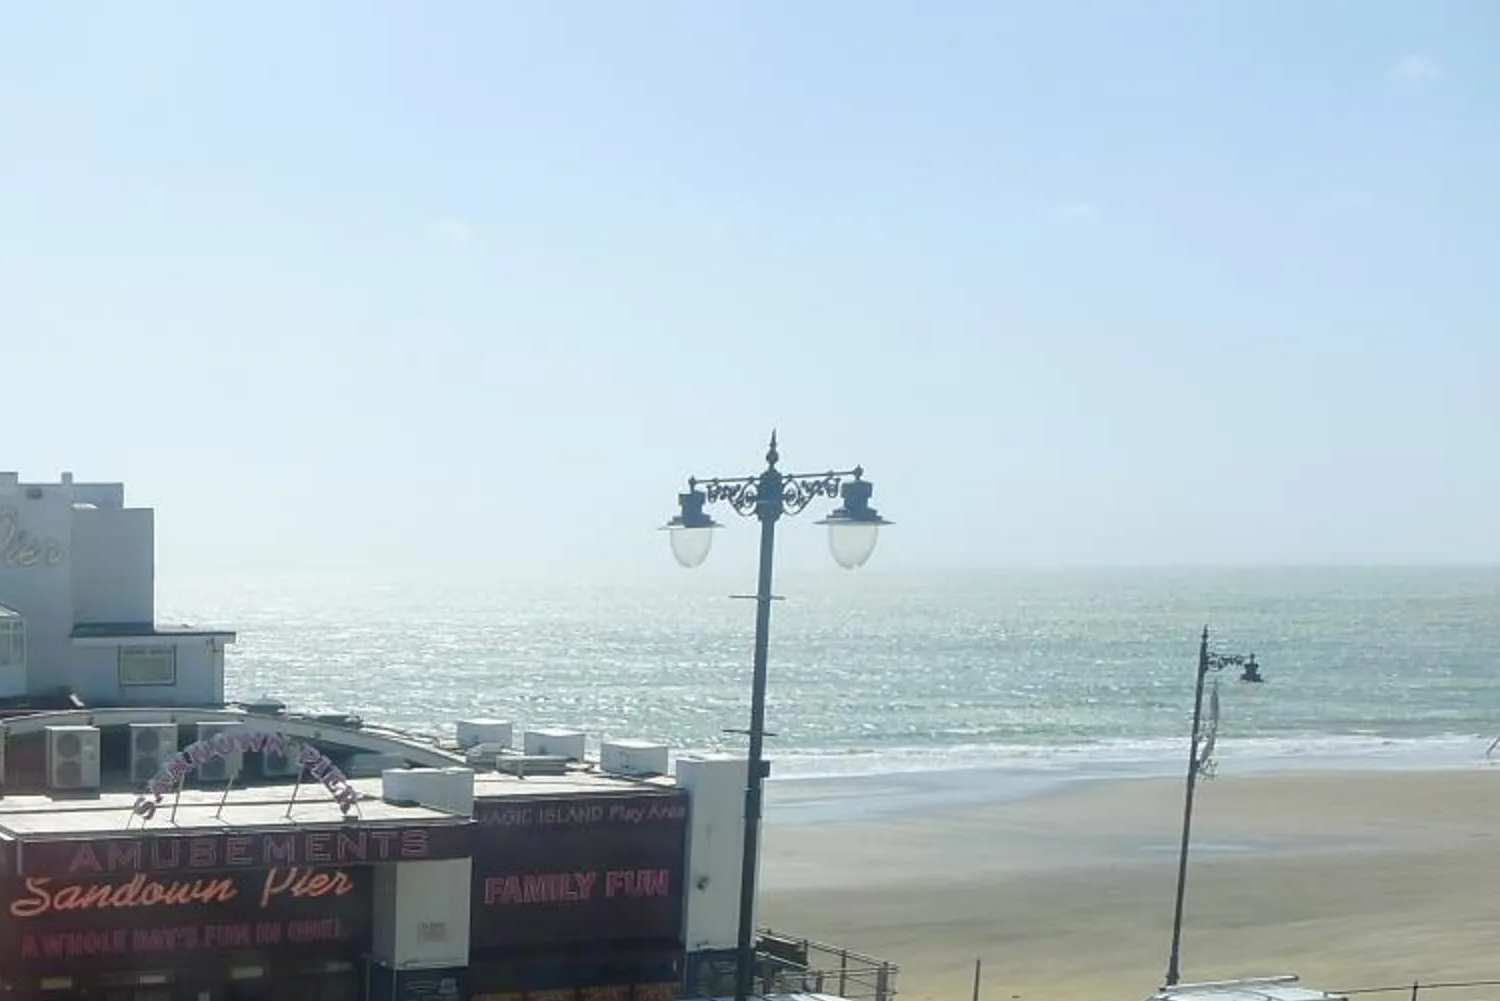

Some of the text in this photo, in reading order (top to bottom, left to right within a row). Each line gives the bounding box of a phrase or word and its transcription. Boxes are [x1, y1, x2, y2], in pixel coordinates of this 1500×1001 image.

[539, 804, 604, 825] ISLAND
[68, 831, 431, 872] AMUSEMENTS
[10, 867, 355, 918] Sandown Pier
[484, 869, 670, 905] FAMILY FUN
